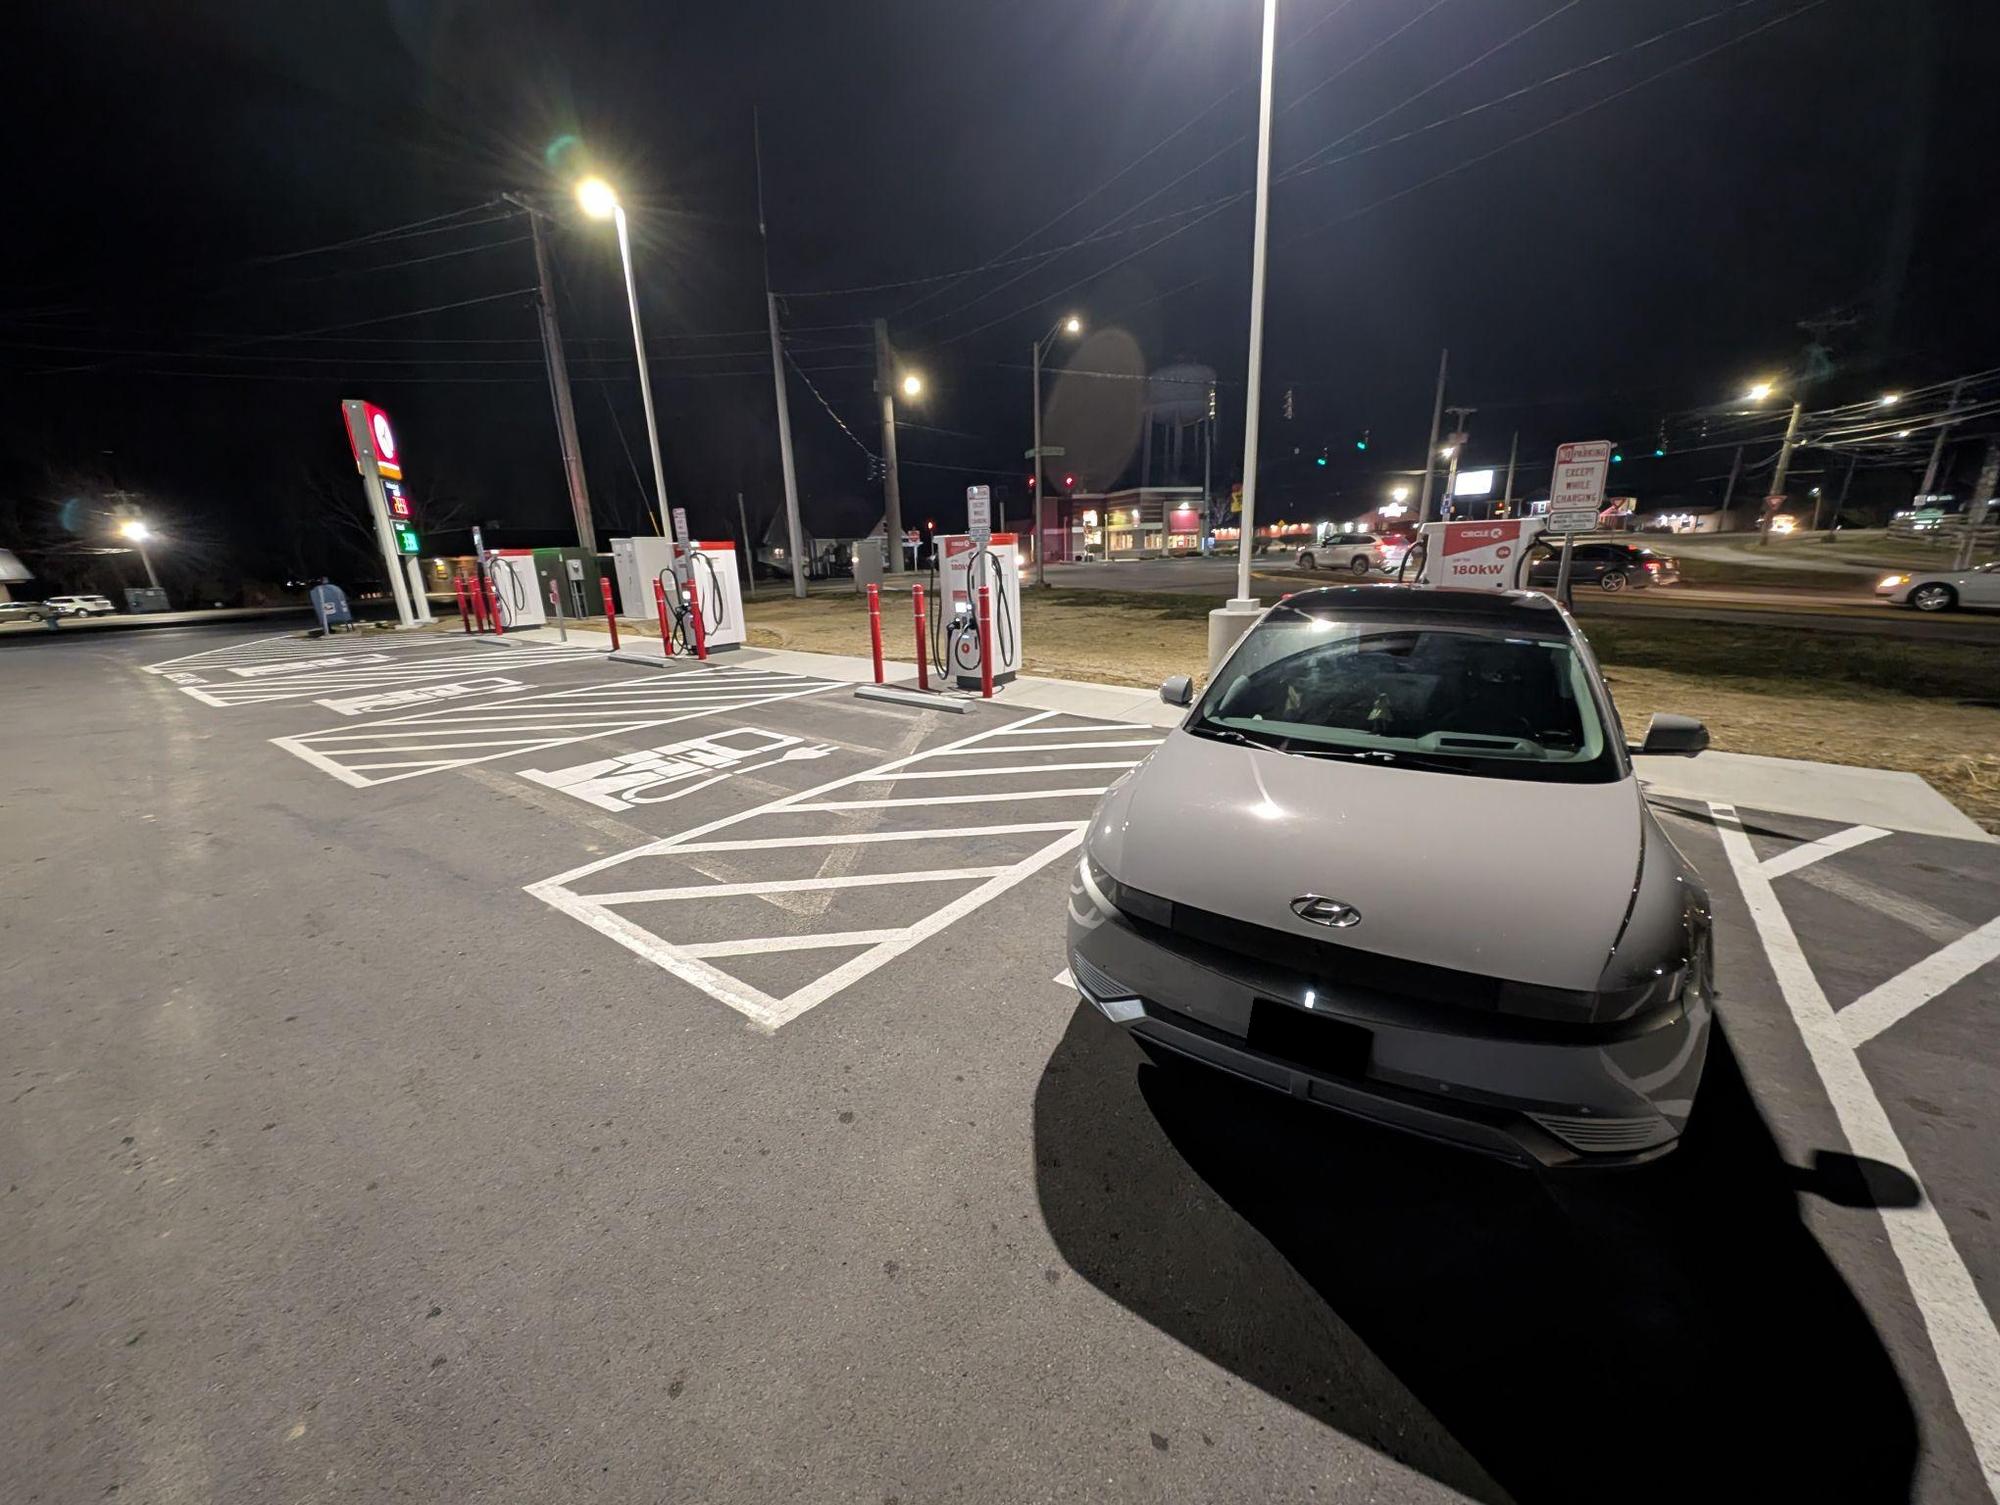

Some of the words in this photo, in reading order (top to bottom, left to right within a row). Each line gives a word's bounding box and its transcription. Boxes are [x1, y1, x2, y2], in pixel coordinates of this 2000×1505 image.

[1566, 467, 1594, 477] EXCEPT
[1566, 481, 1591, 490] WHILE
[1556, 493, 1597, 504] CHARGING
[1461, 530, 1489, 538] CIRCLE
[1453, 564, 1504, 575] 180kW
